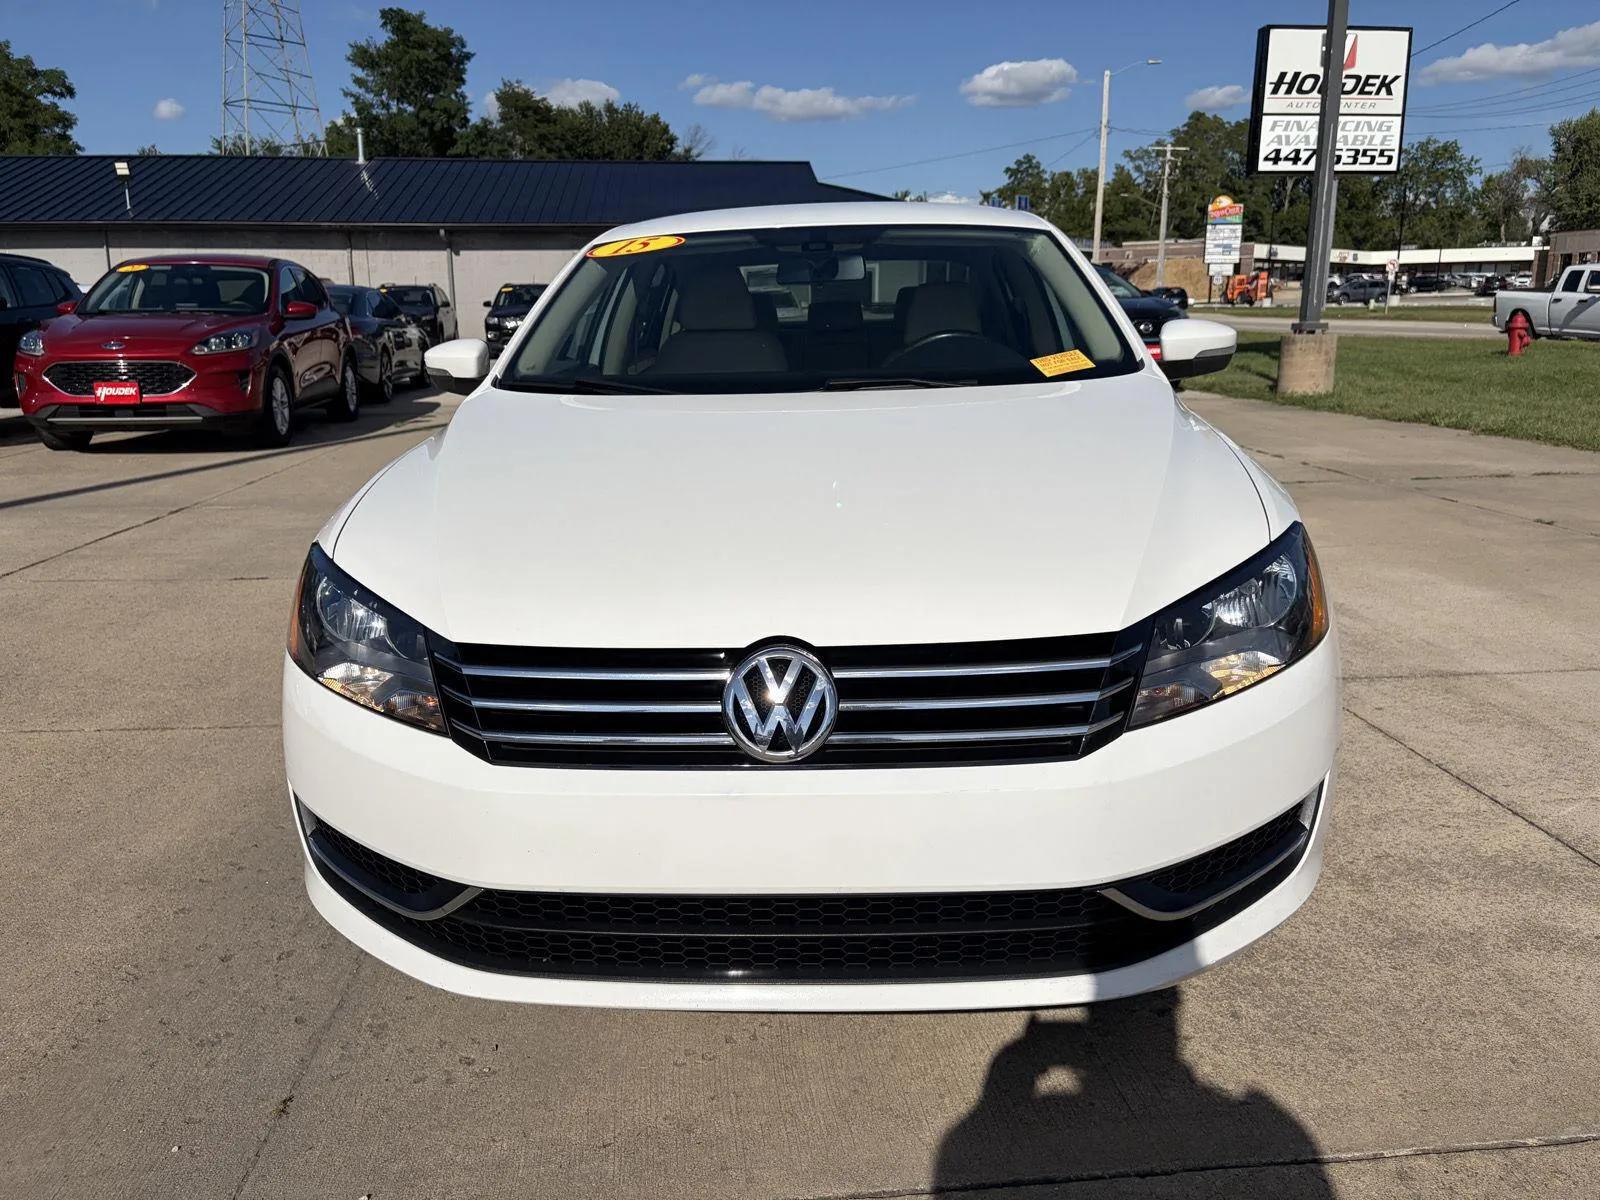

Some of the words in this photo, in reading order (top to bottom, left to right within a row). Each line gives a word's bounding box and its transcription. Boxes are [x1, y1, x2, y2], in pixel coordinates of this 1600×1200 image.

[1269, 71, 1401, 96] HODEK
[1269, 120, 1394, 132] FINACING
[1266, 134, 1395, 147] AVAIABLE
[96, 386, 137, 401] HOUDEK
